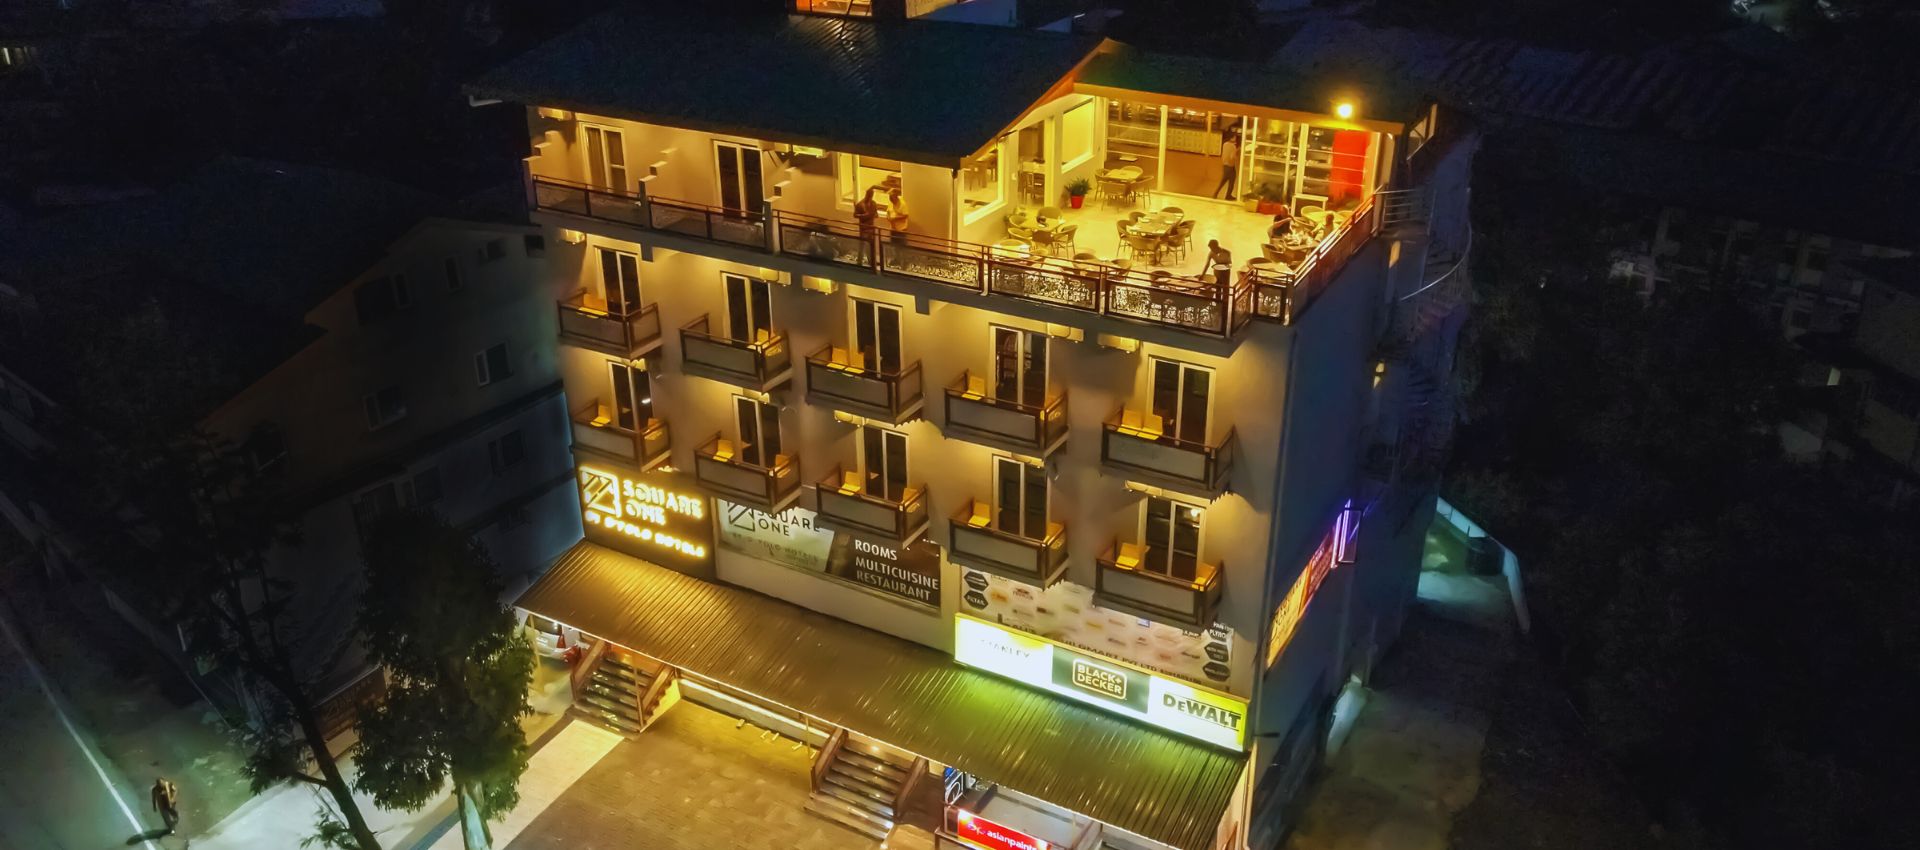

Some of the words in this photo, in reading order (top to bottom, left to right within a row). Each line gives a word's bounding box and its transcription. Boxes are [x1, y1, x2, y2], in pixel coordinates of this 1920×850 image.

[623, 479, 704, 520] SQUARE
[625, 499, 667, 526] ONE
[758, 518, 790, 537] ONE
[854, 539, 898, 561] ROOMS
[855, 556, 939, 590] MULTICUISINE
[856, 570, 931, 601] RESTAURANT
[1077, 664, 1122, 685] BLACK+
[1077, 673, 1122, 695] DECKER
